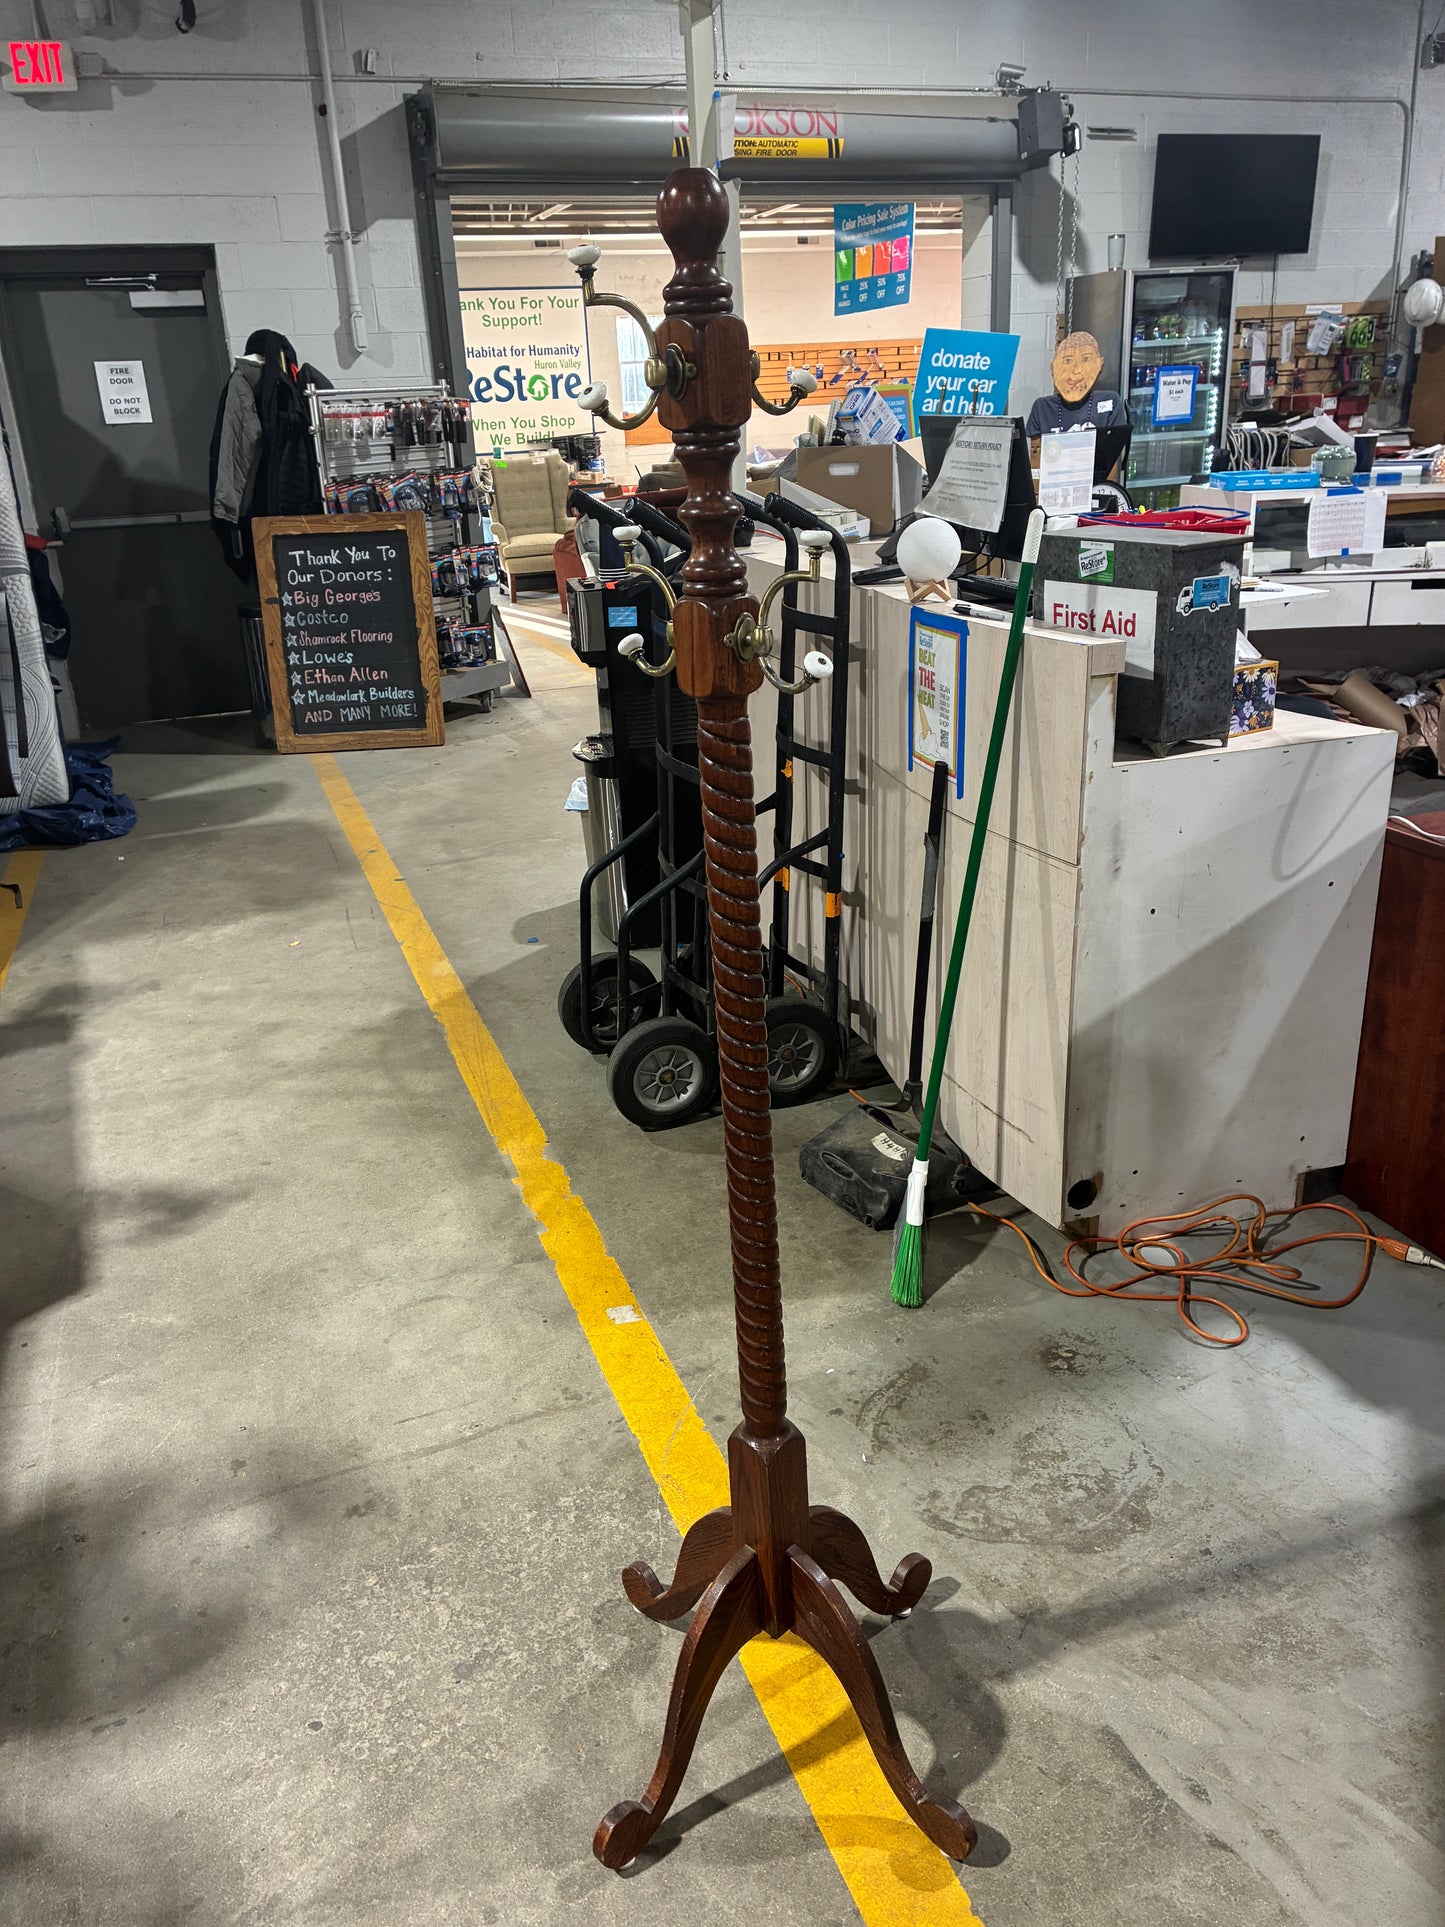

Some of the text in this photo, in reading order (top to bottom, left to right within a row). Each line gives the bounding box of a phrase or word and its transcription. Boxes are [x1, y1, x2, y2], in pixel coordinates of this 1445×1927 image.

[9, 42, 64, 84] EXIT
[678, 102, 838, 137] OKSON
[758, 140, 799, 148] AUTOMATIC
[841, 218, 856, 231] Color
[857, 213, 876, 227] Pricing
[877, 209, 889, 222] Sale
[890, 204, 909, 220] System
[859, 293, 868, 302] OFF
[877, 289, 886, 299] OFF
[896, 285, 905, 295] OFF
[460, 296, 579, 311] ank You For Your
[482, 313, 543, 330] Support!
[466, 344, 580, 358] Habitat for Humanity
[931, 348, 991, 371] donate
[110, 367, 130, 375] FIRE
[534, 359, 582, 370] Huron Valley
[109, 377, 134, 385] DOOR
[925, 375, 997, 394] your car
[114, 407, 141, 415] BLOCK
[921, 395, 994, 416] and help
[510, 417, 536, 429] You
[541, 415, 576, 429] Shop
[489, 431, 555, 446] We Build!
[288, 545, 396, 567] Thank You To
[287, 569, 315, 585] Our
[293, 590, 319, 607] Big
[297, 609, 349, 627] Costco
[1053, 602, 1137, 637] First Aid
[299, 629, 393, 647] Shamrock Flooring
[302, 650, 354, 665] Lowe's
[918, 648, 936, 668] BEAT
[304, 667, 388, 684] Ethan Allen
[918, 666, 936, 692] THE
[307, 686, 415, 704] Meadowlark Builders
[917, 689, 936, 709] HEAT
[305, 703, 418, 723] AND MANY MORE!
